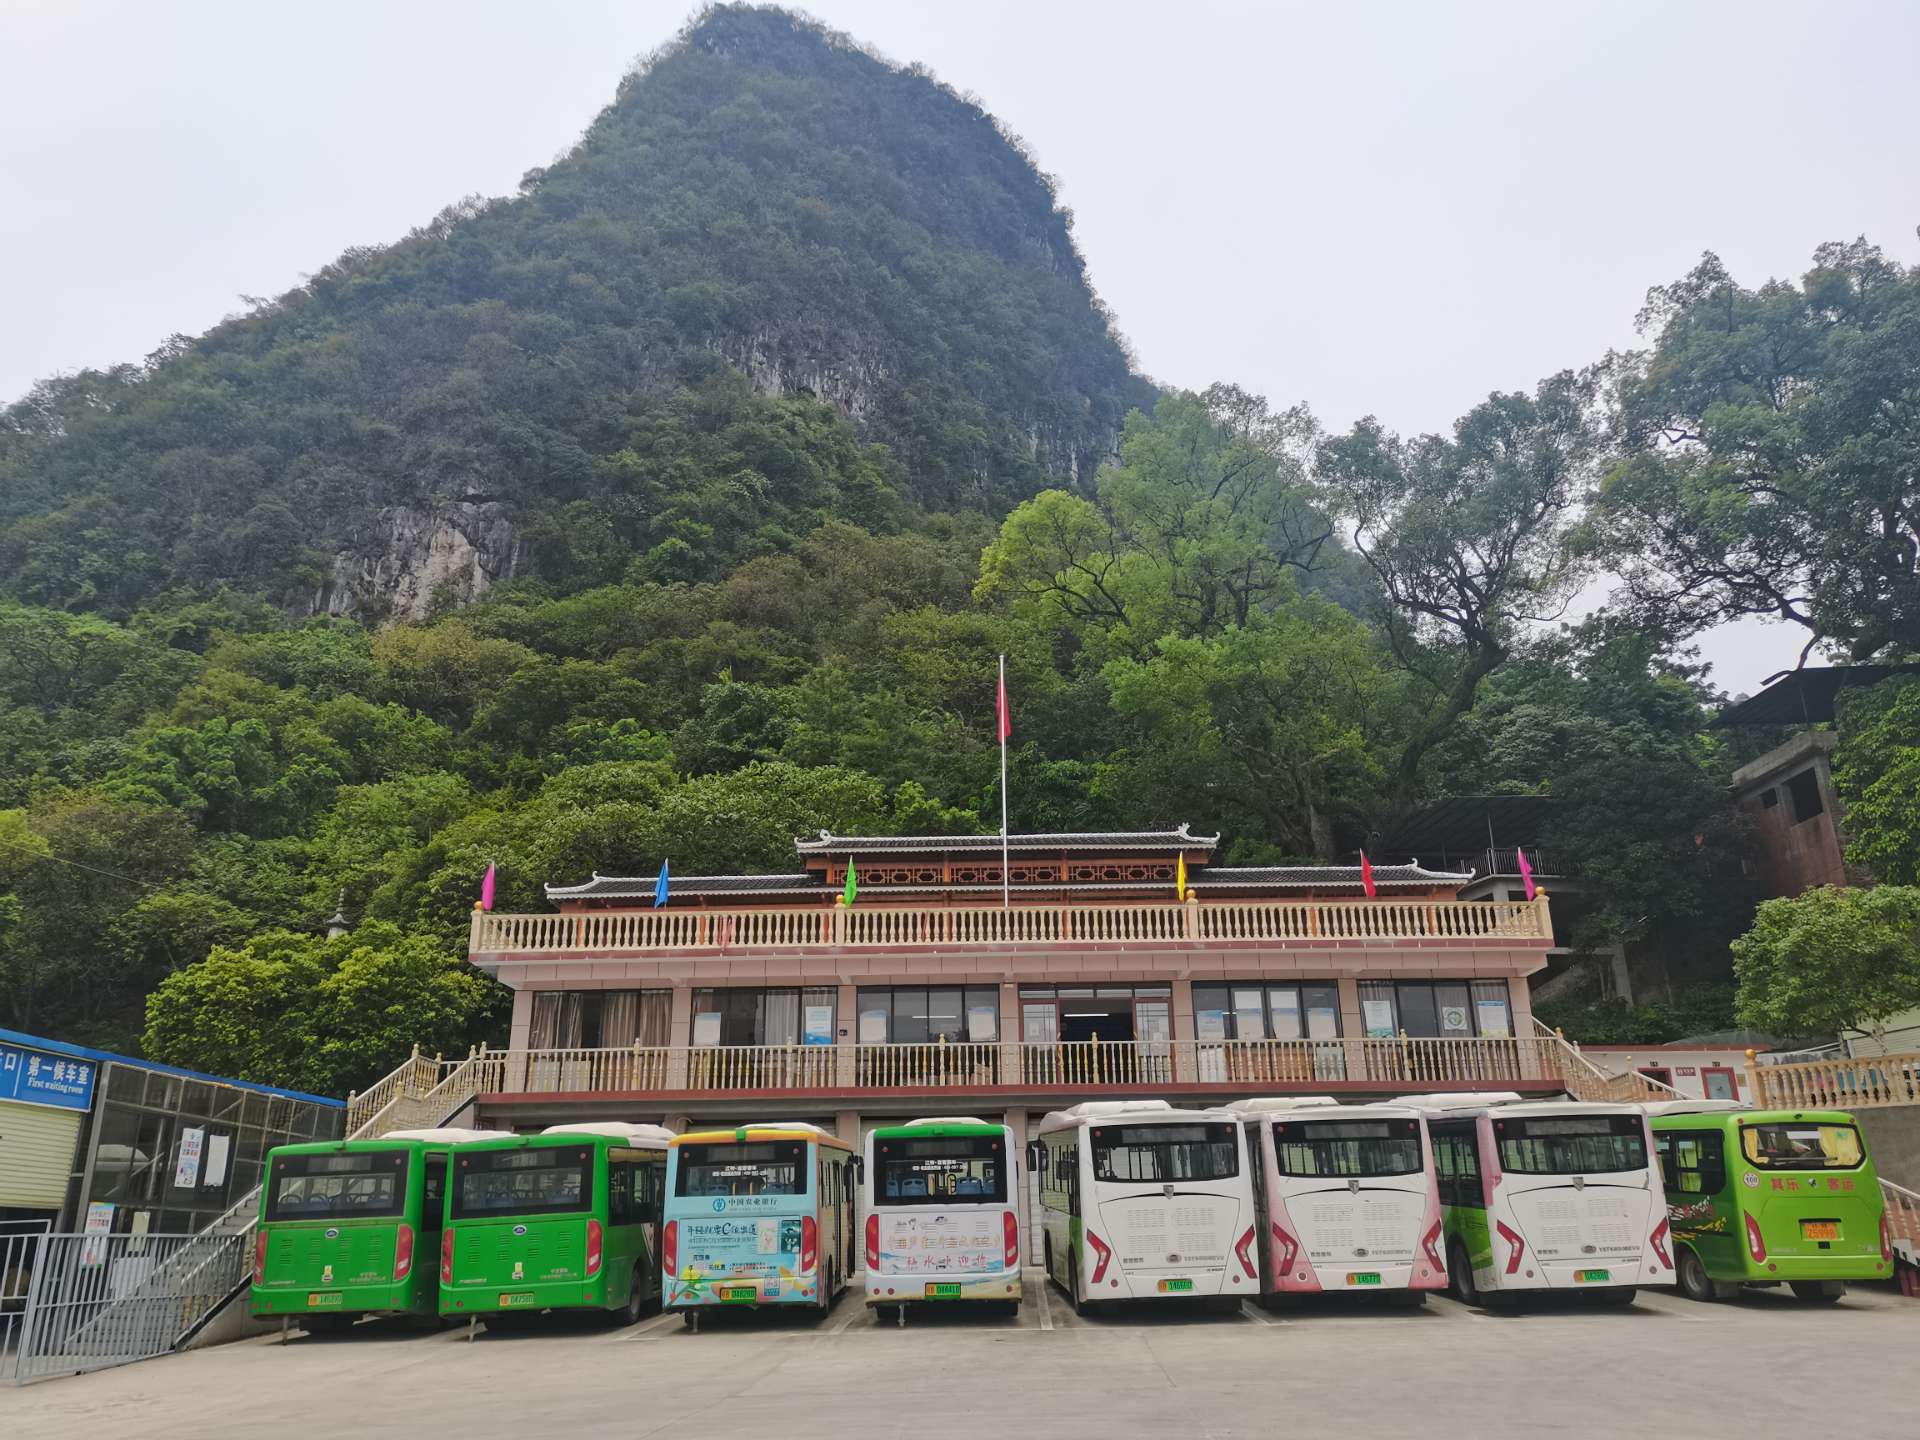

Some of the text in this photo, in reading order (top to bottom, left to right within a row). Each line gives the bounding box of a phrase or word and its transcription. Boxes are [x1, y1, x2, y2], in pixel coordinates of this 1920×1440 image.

[27, 1055, 89, 1085] 第一候车室
[28, 1077, 84, 1094] First waiting room
[728, 1198, 777, 1207] 中国农业银行
